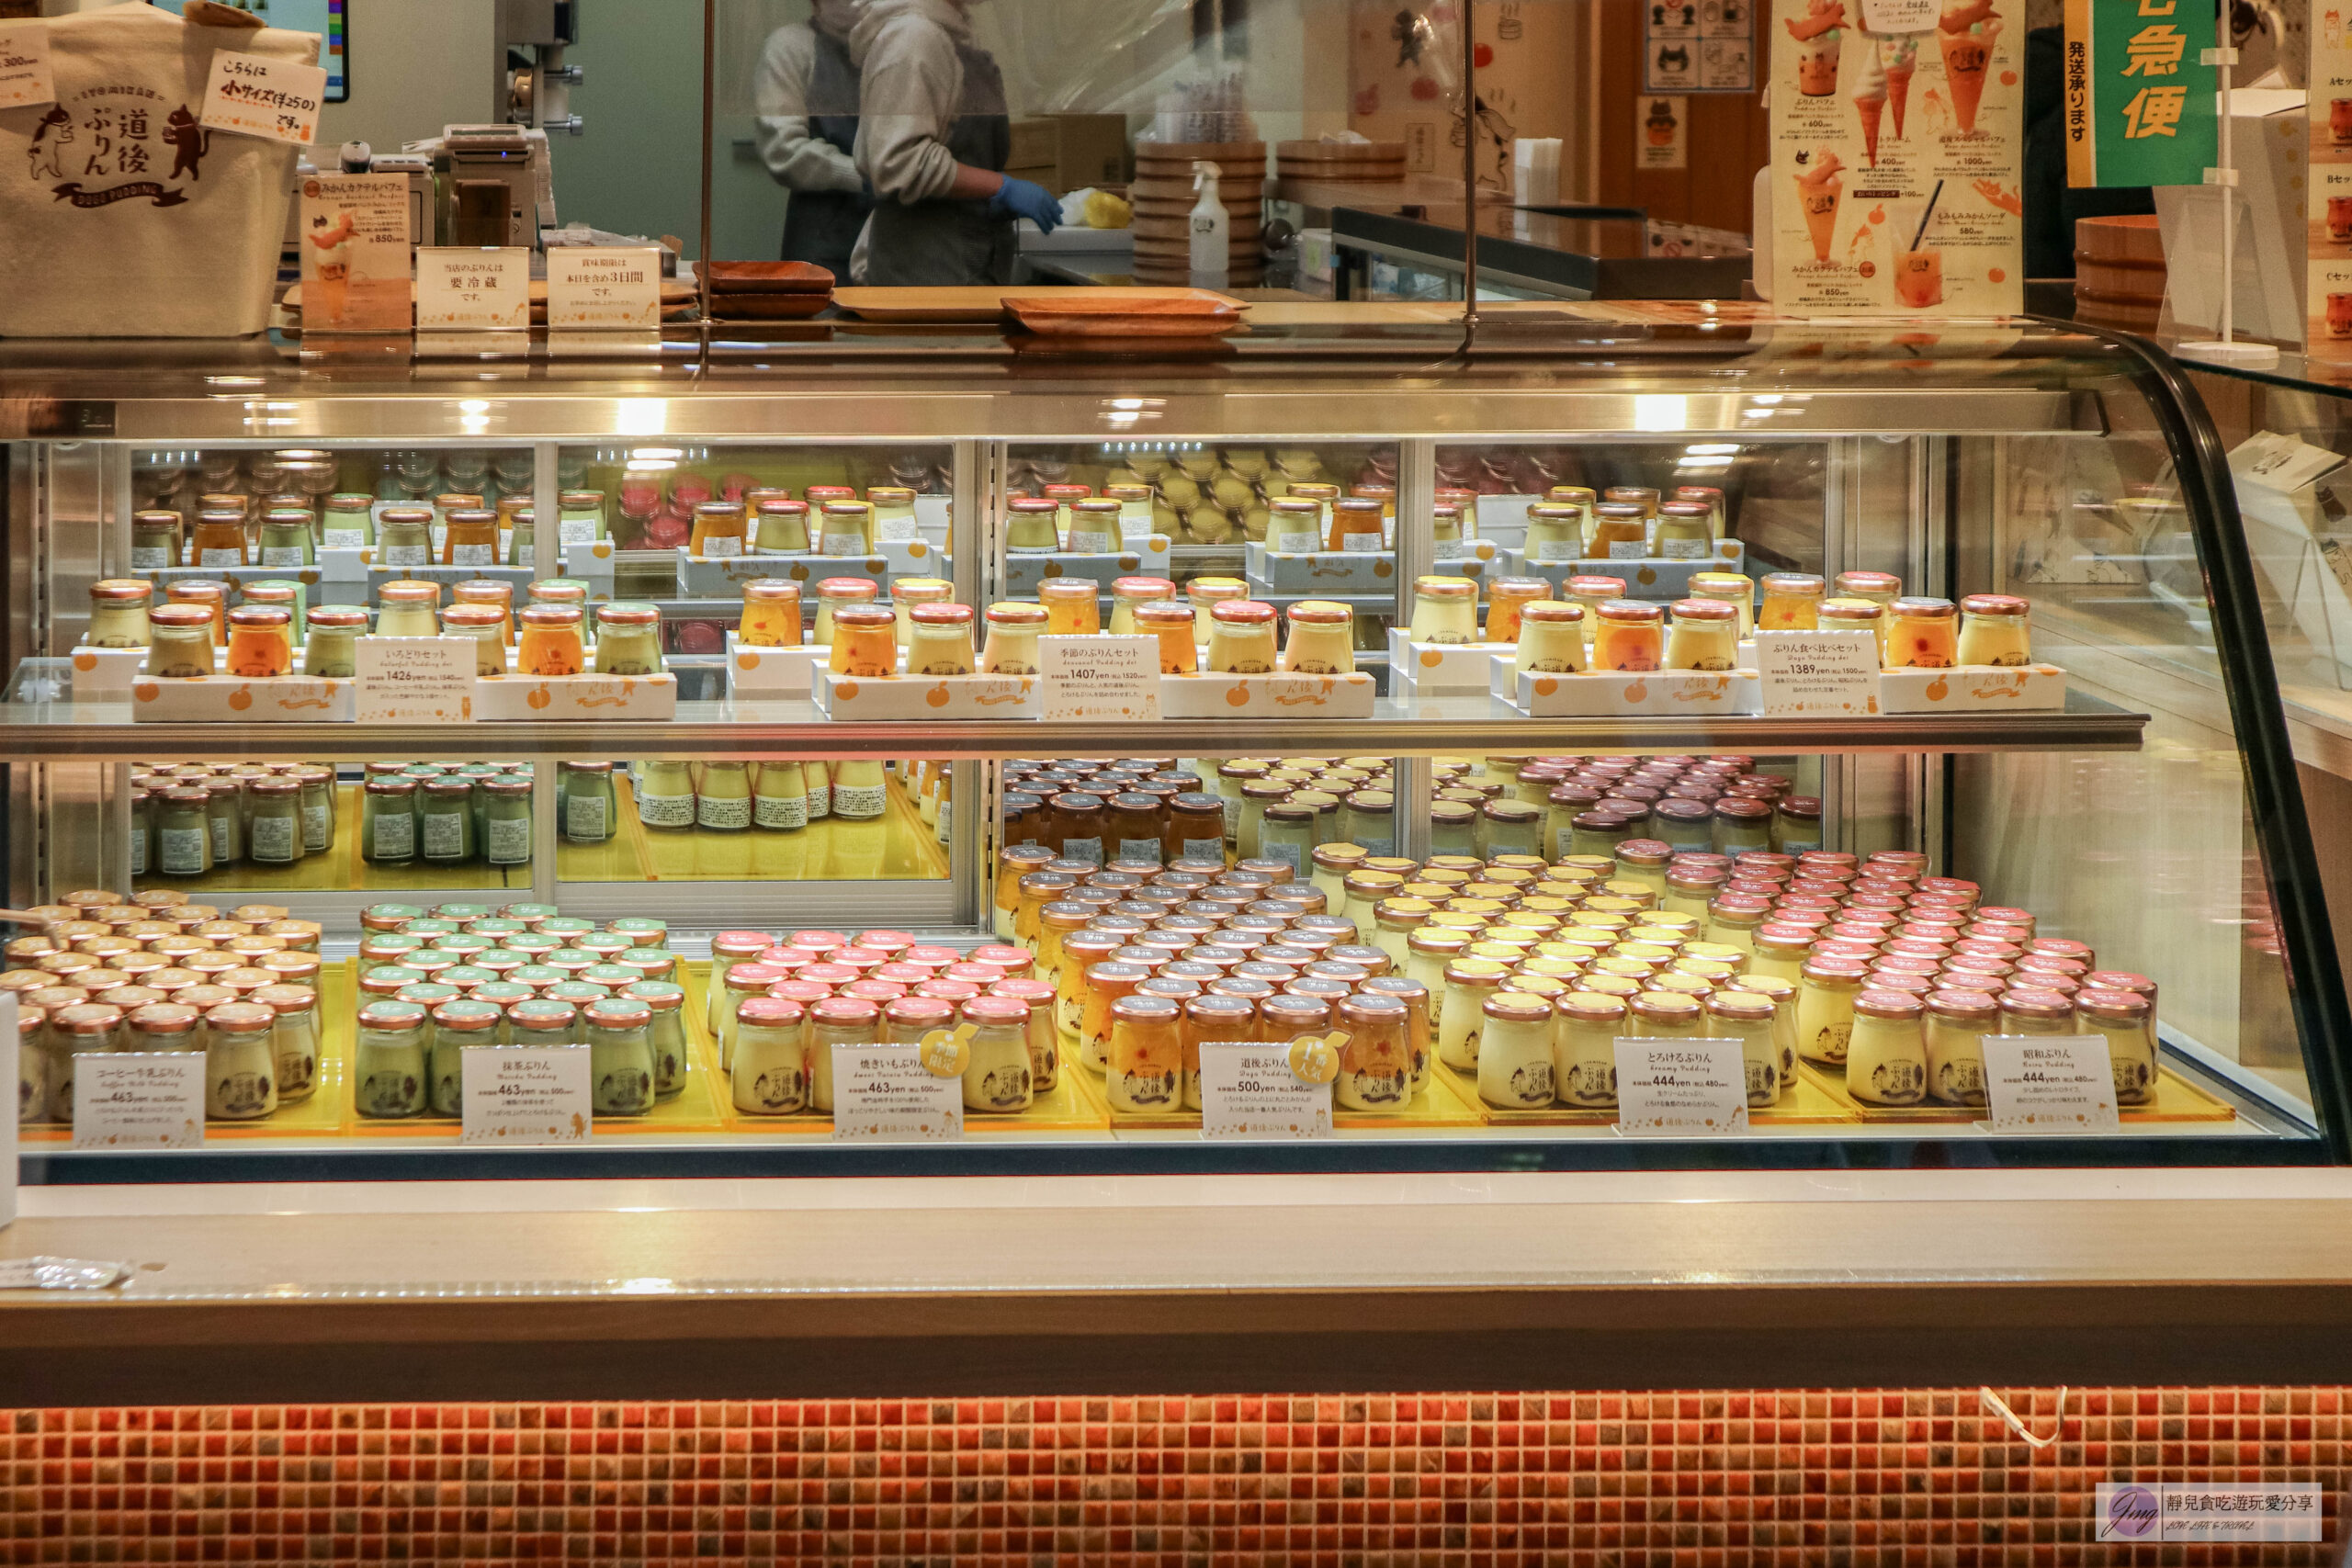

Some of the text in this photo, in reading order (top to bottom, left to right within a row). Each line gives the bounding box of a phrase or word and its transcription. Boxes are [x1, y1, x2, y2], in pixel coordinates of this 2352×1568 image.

[222, 60, 268, 76] こちらは
[2329, 77, 2352, 86] Aセッ
[2069, 41, 2086, 142] 発送承ります
[277, 114, 300, 130] です。
[84, 107, 112, 175] ぷりん
[118, 108, 150, 175] 道後
[2327, 175, 2352, 184] Bセッ
[321, 182, 404, 192] みかんカクテルパフェ
[109, 185, 158, 201] PUDDING
[582, 258, 627, 267] 賞味期限は
[443, 264, 503, 273] 当店のぷりんは
[450, 276, 498, 288] 要冷蔵
[566, 271, 644, 284] 本日を含め3日間
[2326, 272, 2352, 281] Cセッ
[460, 292, 481, 302] です。
[592, 288, 612, 297] です。
[1060, 648, 1139, 658] 季節のぷりんセット
[1773, 643, 1860, 653] ぷりん食べ比べセット
[386, 649, 447, 660] いろどりセット
[1070, 669, 1110, 681] 1407yen
[1790, 664, 1830, 675] 1389yen
[387, 671, 426, 682] 1426yen
[1647, 1053, 1713, 1063] とろけるぷりん
[2022, 1049, 2071, 1059] 昭和ぷりん
[503, 1061, 551, 1071] 抹茶ぷりん
[929, 1054, 956, 1073] 限定
[1240, 1057, 1289, 1068] 道後ぷりん
[96, 1067, 185, 1078] コーヒー牛乳ぷりん
[1298, 1063, 1321, 1081] 人気
[1680, 1065, 1711, 1073] Pudding
[1652, 1075, 1691, 1088] 444yen
[2022, 1072, 2061, 1084] 444yen
[498, 1084, 536, 1096] 463yen
[868, 1082, 905, 1094] 463yen
[1238, 1081, 1275, 1093] 500yen
